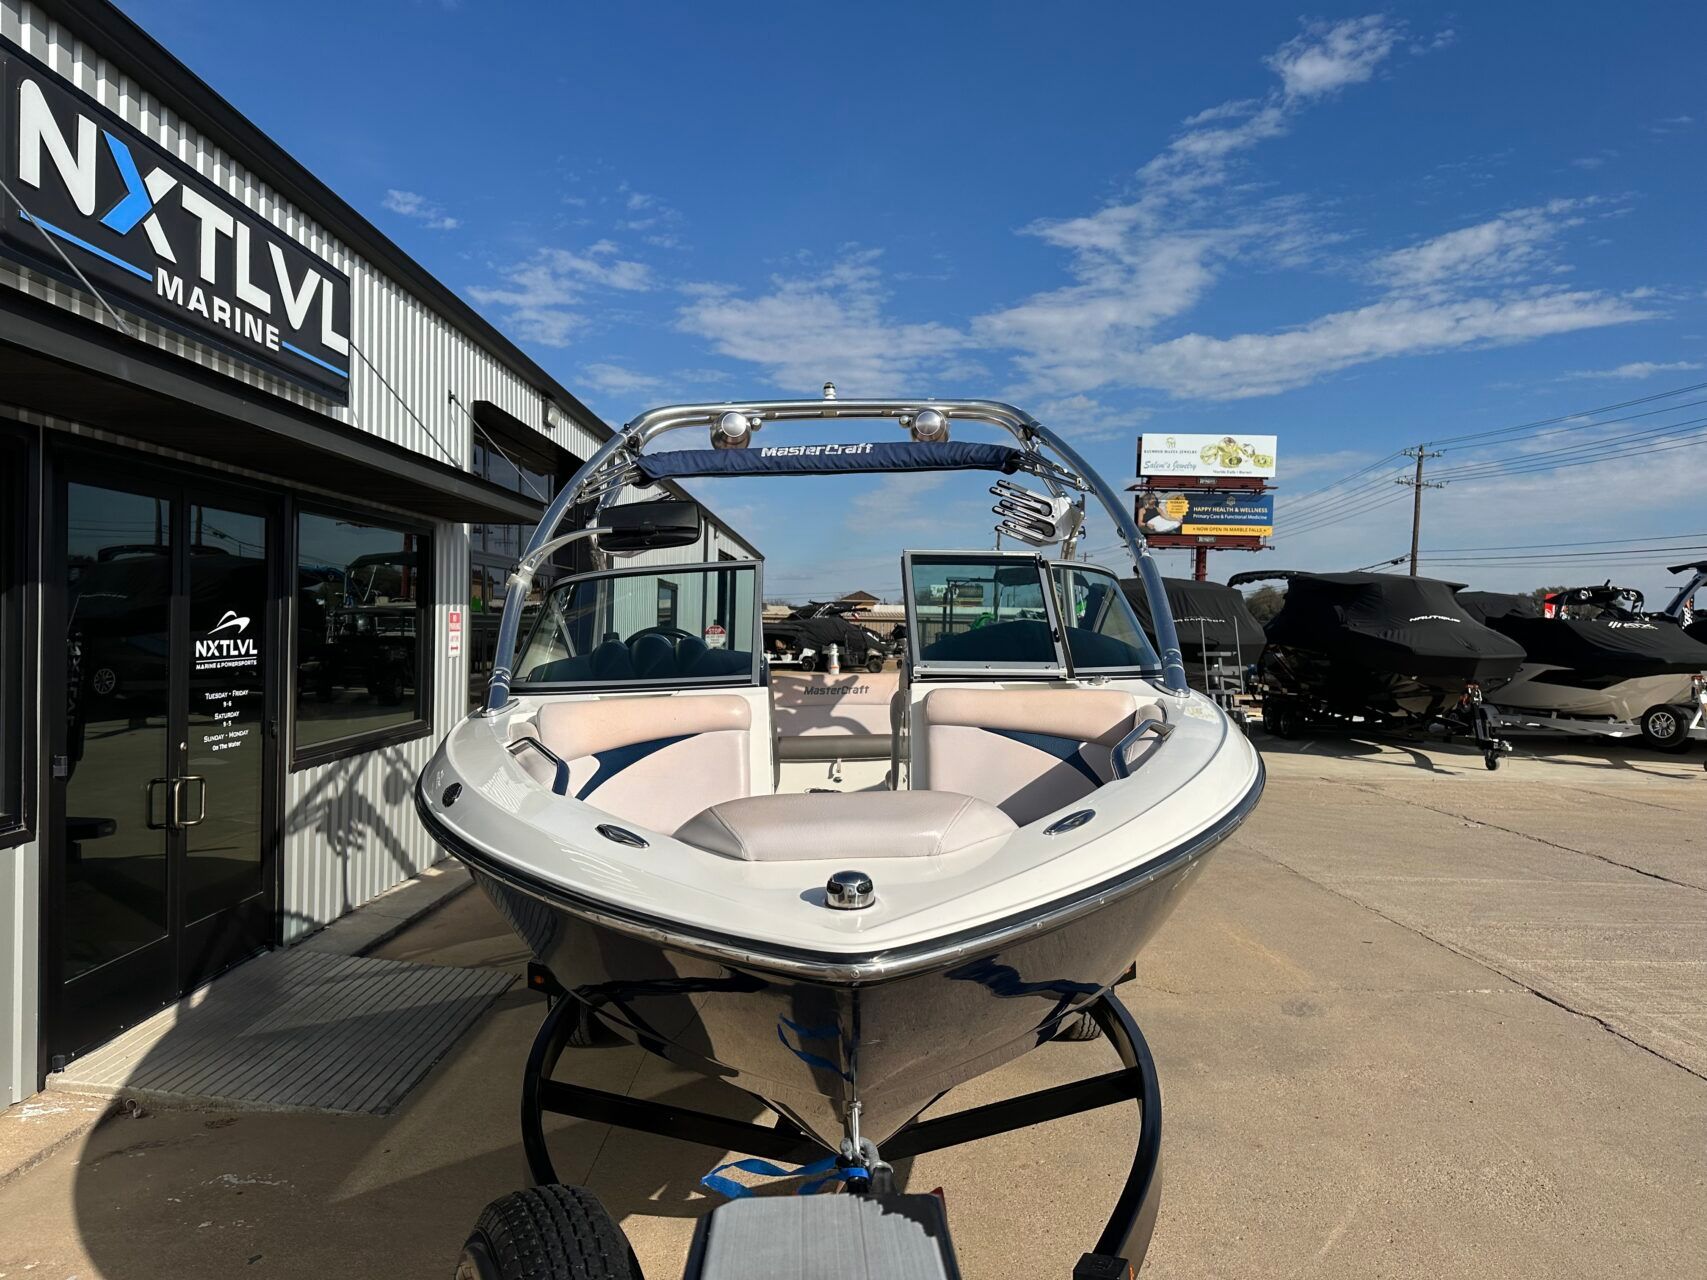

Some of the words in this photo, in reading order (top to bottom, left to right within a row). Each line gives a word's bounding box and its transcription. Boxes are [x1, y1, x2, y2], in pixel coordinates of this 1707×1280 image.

[18, 78, 350, 357] NXTLVL
[157, 267, 281, 352] MARINE
[761, 442, 873, 457] MasterCraft
[195, 639, 258, 658] NXTLVL
[221, 660, 257, 668] POWERSPORTS
[803, 685, 870, 695] MasterCraft
[228, 740, 242, 749] Water
